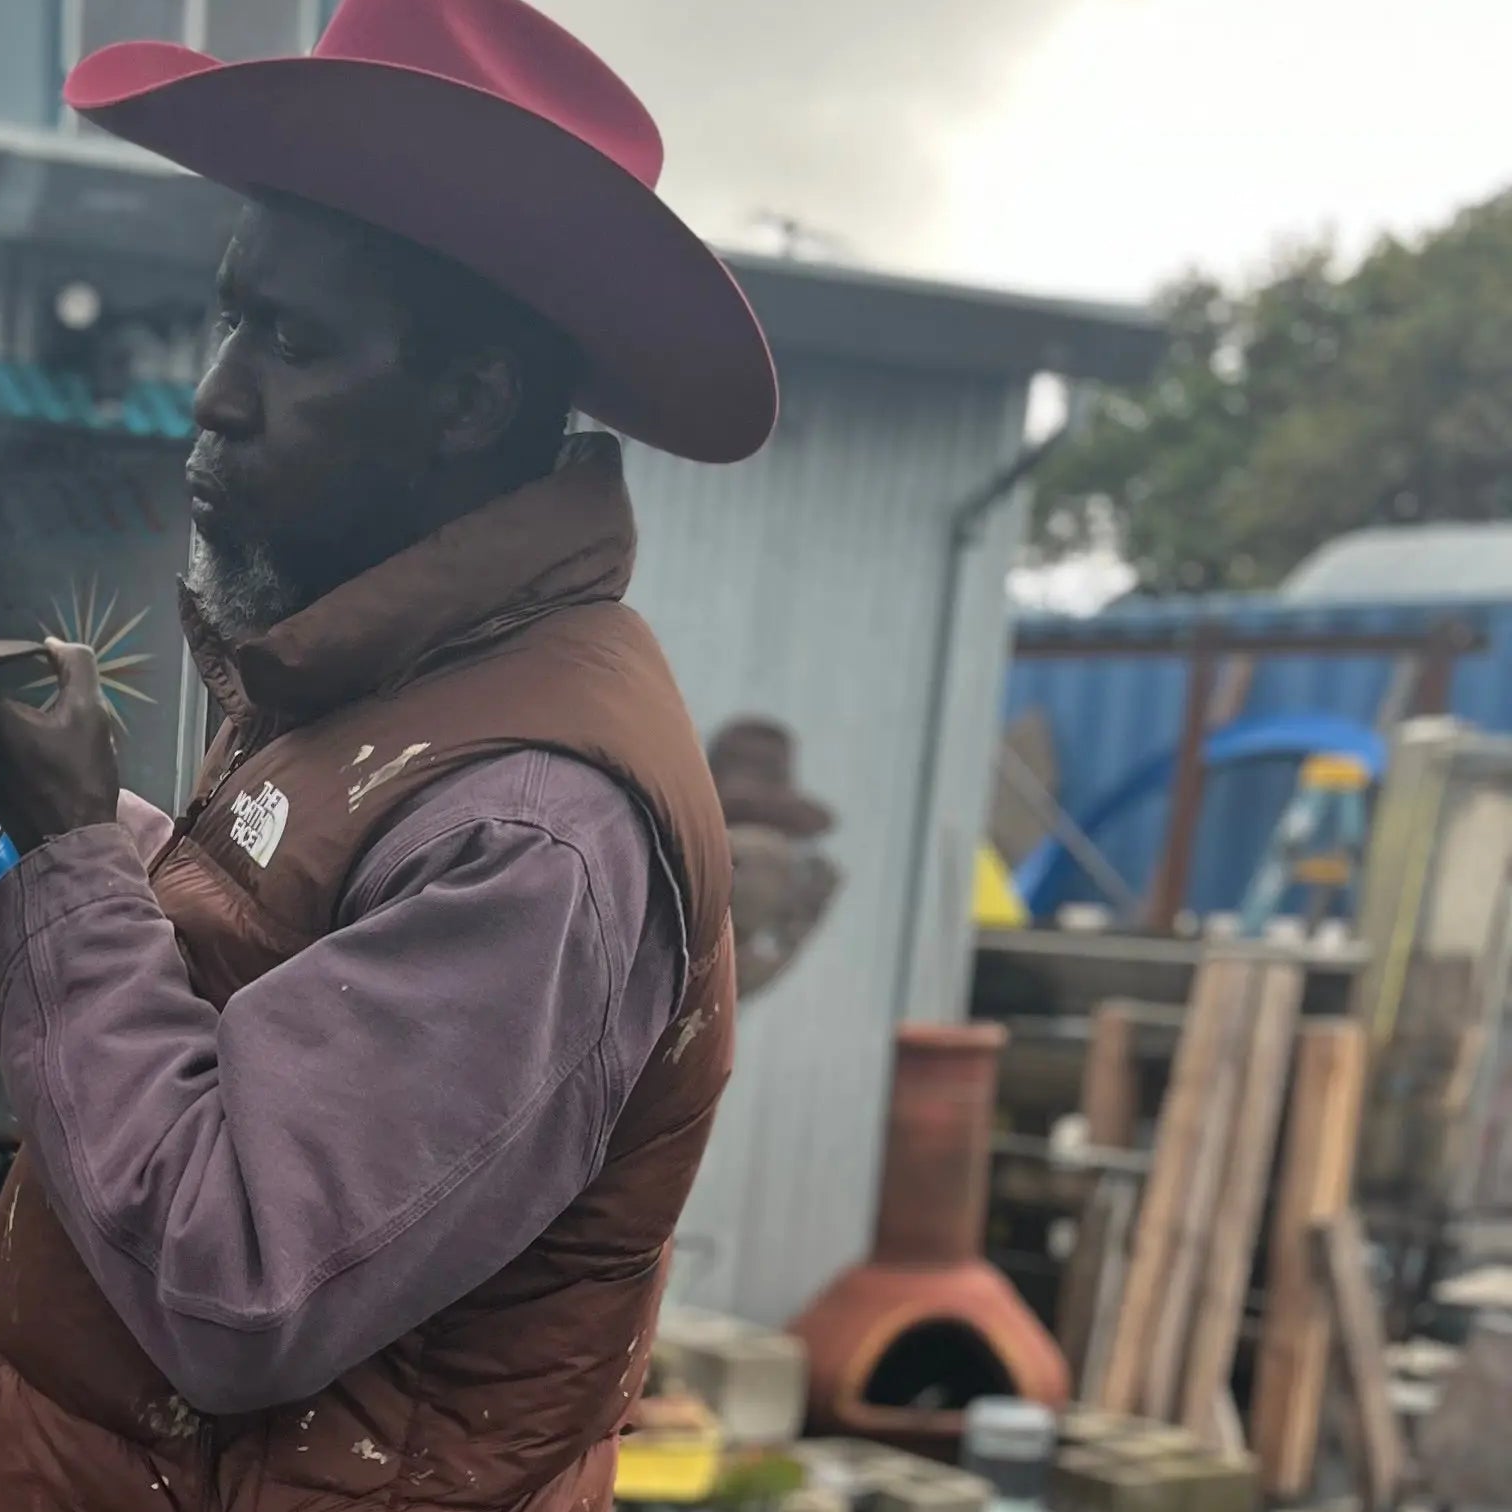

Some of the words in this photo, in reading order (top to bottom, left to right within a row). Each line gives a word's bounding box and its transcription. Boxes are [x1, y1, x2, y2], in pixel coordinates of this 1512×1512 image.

[230, 790, 271, 833] NORTH
[255, 781, 284, 810] THE
[230, 816, 258, 852] FACE
